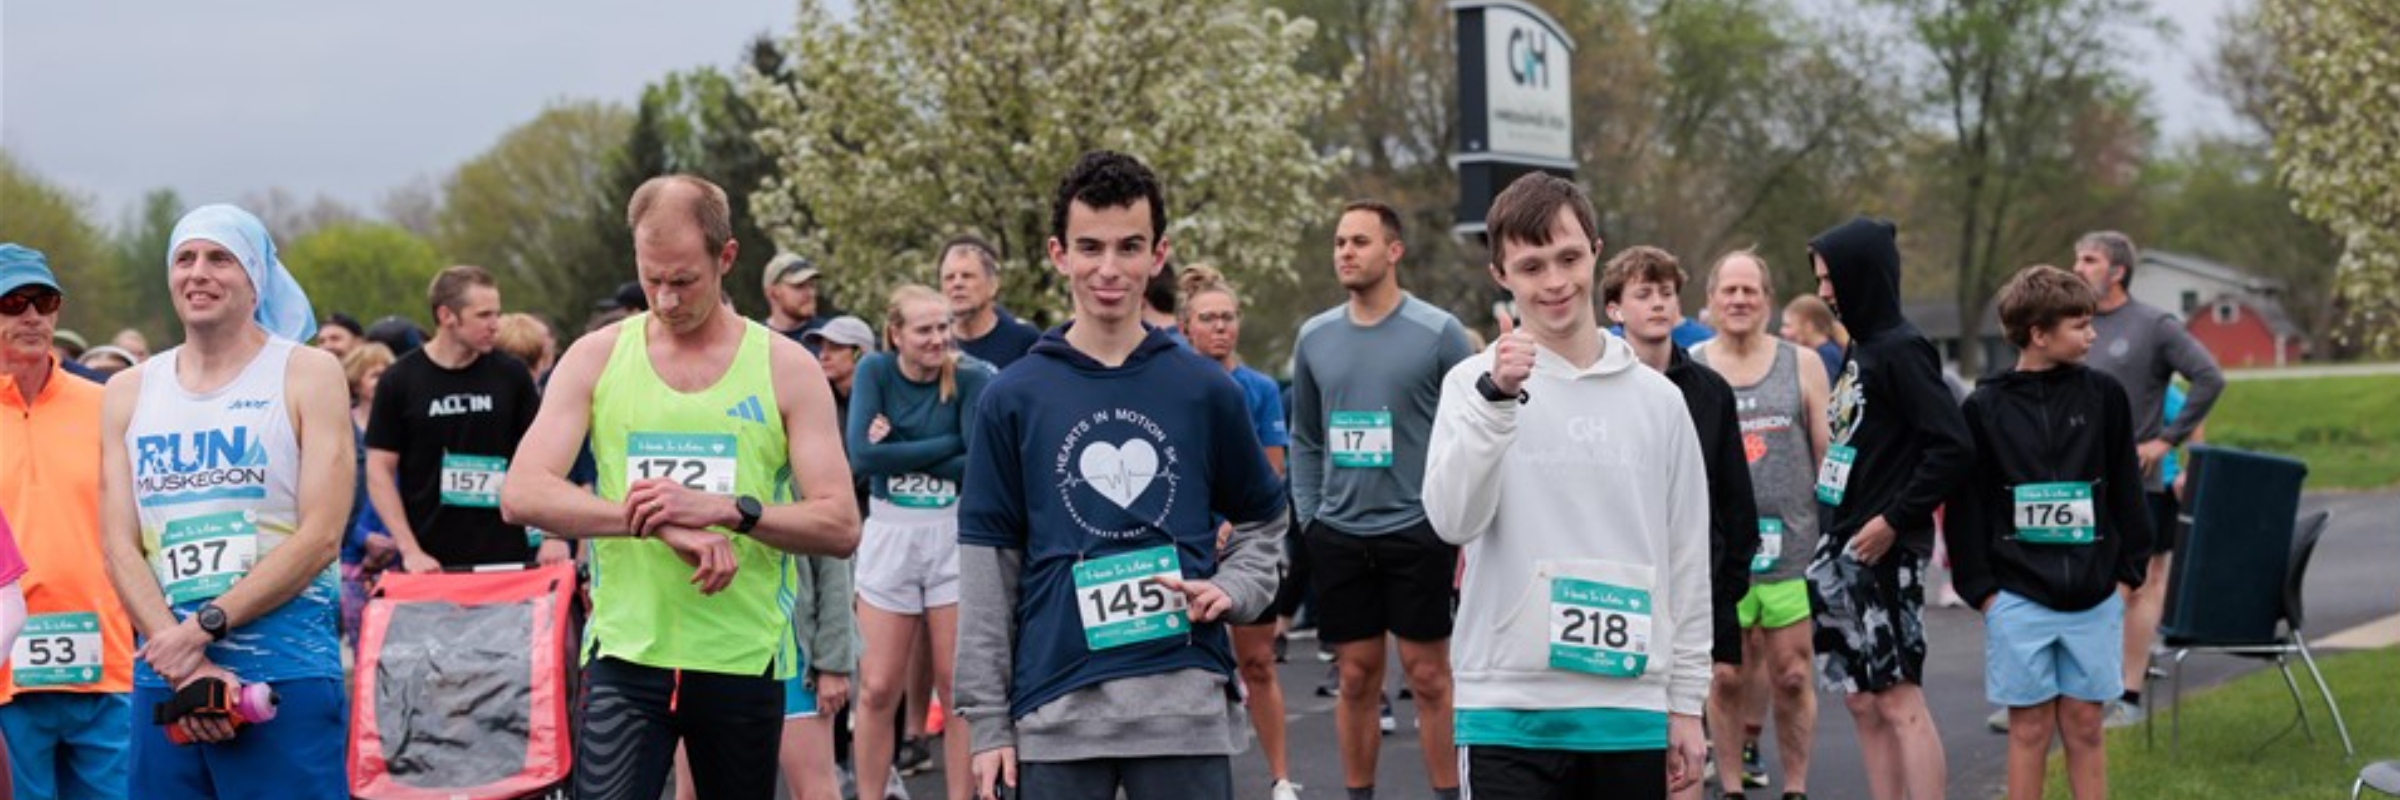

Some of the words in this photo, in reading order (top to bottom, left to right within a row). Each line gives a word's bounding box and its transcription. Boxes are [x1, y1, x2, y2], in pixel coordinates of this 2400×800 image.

[429, 395, 467, 417] ALL
[470, 394, 493, 412] IN
[137, 425, 247, 476] RUN
[1056, 420, 1090, 473] HEARTS
[1092, 409, 1109, 424] IN
[1115, 408, 1167, 442] MOTION
[1163, 446, 1179, 466] 5K
[1343, 431, 1365, 450] 17
[138, 468, 265, 492] MUSKEGON
[449, 472, 490, 492] 157
[638, 459, 707, 491] 172
[892, 474, 942, 493] 220
[2025, 503, 2073, 526] 176
[167, 539, 227, 580] 137
[1089, 580, 1165, 623] 145
[1560, 608, 1629, 648] 218
[29, 636, 77, 666] 53
